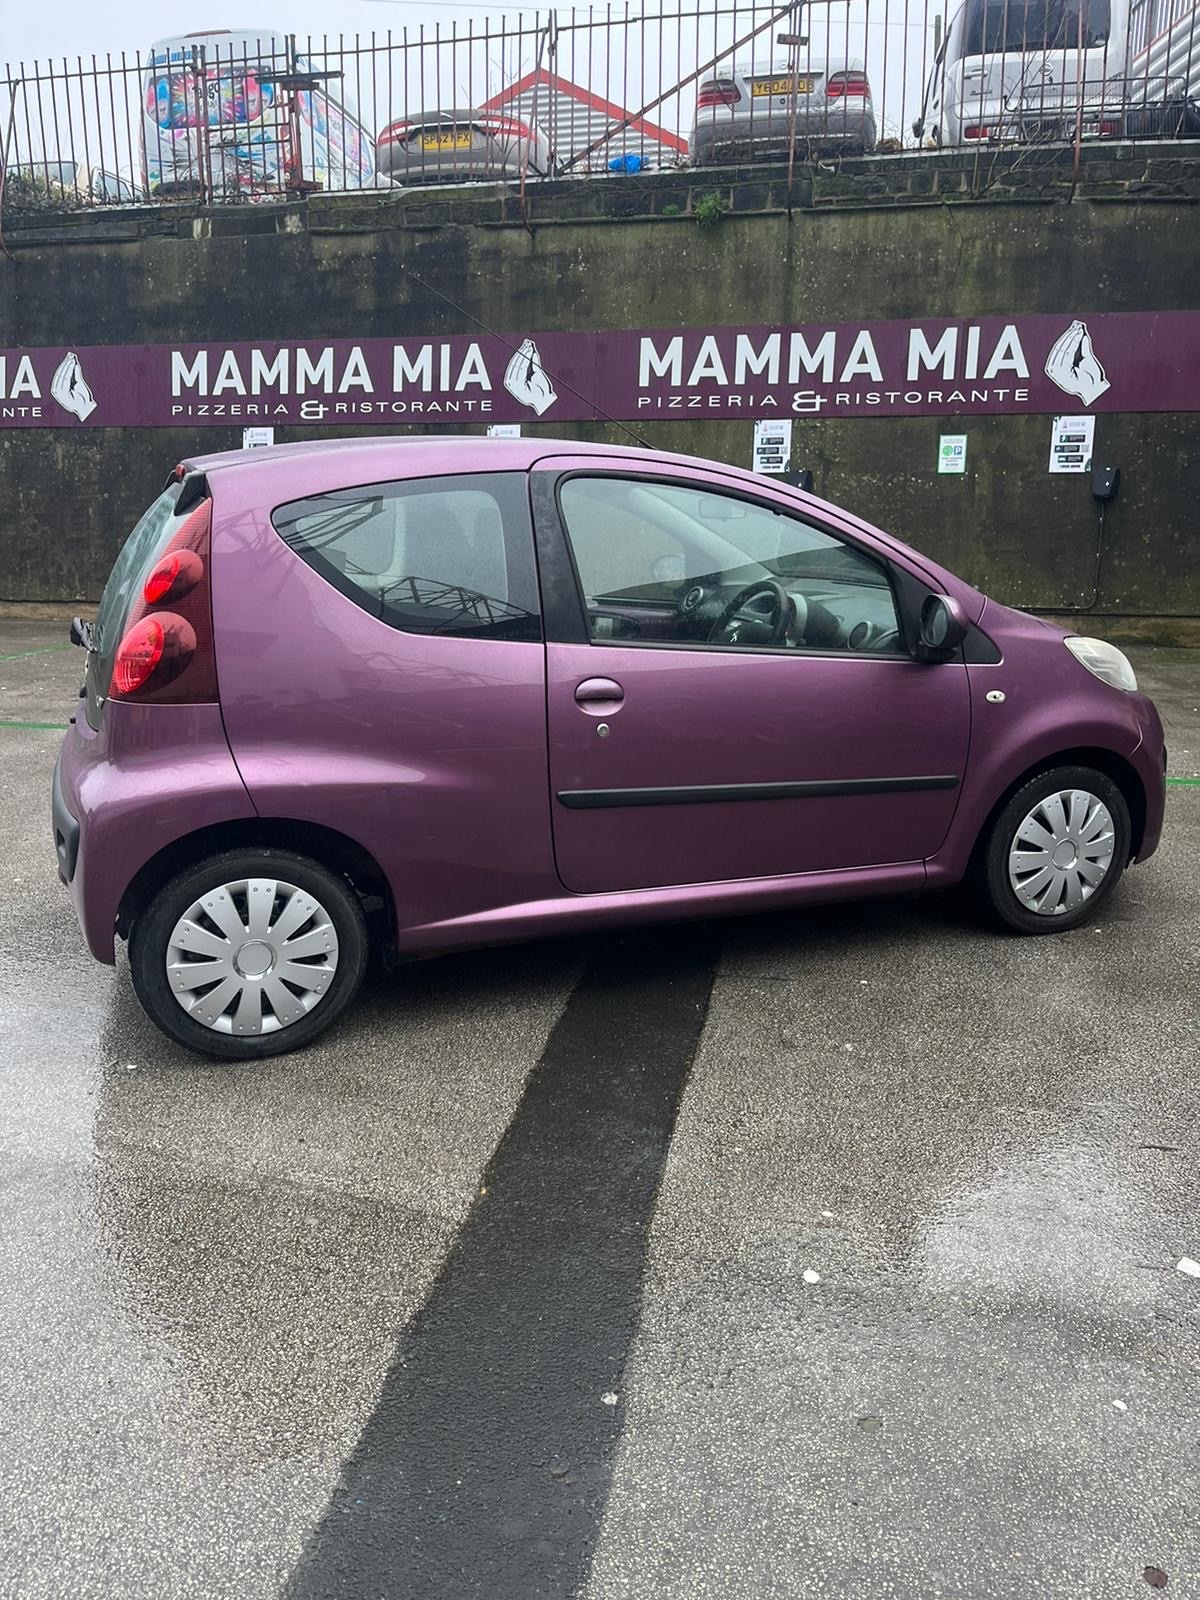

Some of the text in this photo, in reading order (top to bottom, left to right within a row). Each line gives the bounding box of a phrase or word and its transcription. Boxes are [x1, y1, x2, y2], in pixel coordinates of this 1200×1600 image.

[171, 342, 493, 397] MAMMA MIA
[638, 324, 1030, 387] MAMMA MIA
[172, 400, 492, 420] PIZZERIA & RISTORANTE
[638, 388, 1029, 412] PIZZERIA & RISTORANTE
